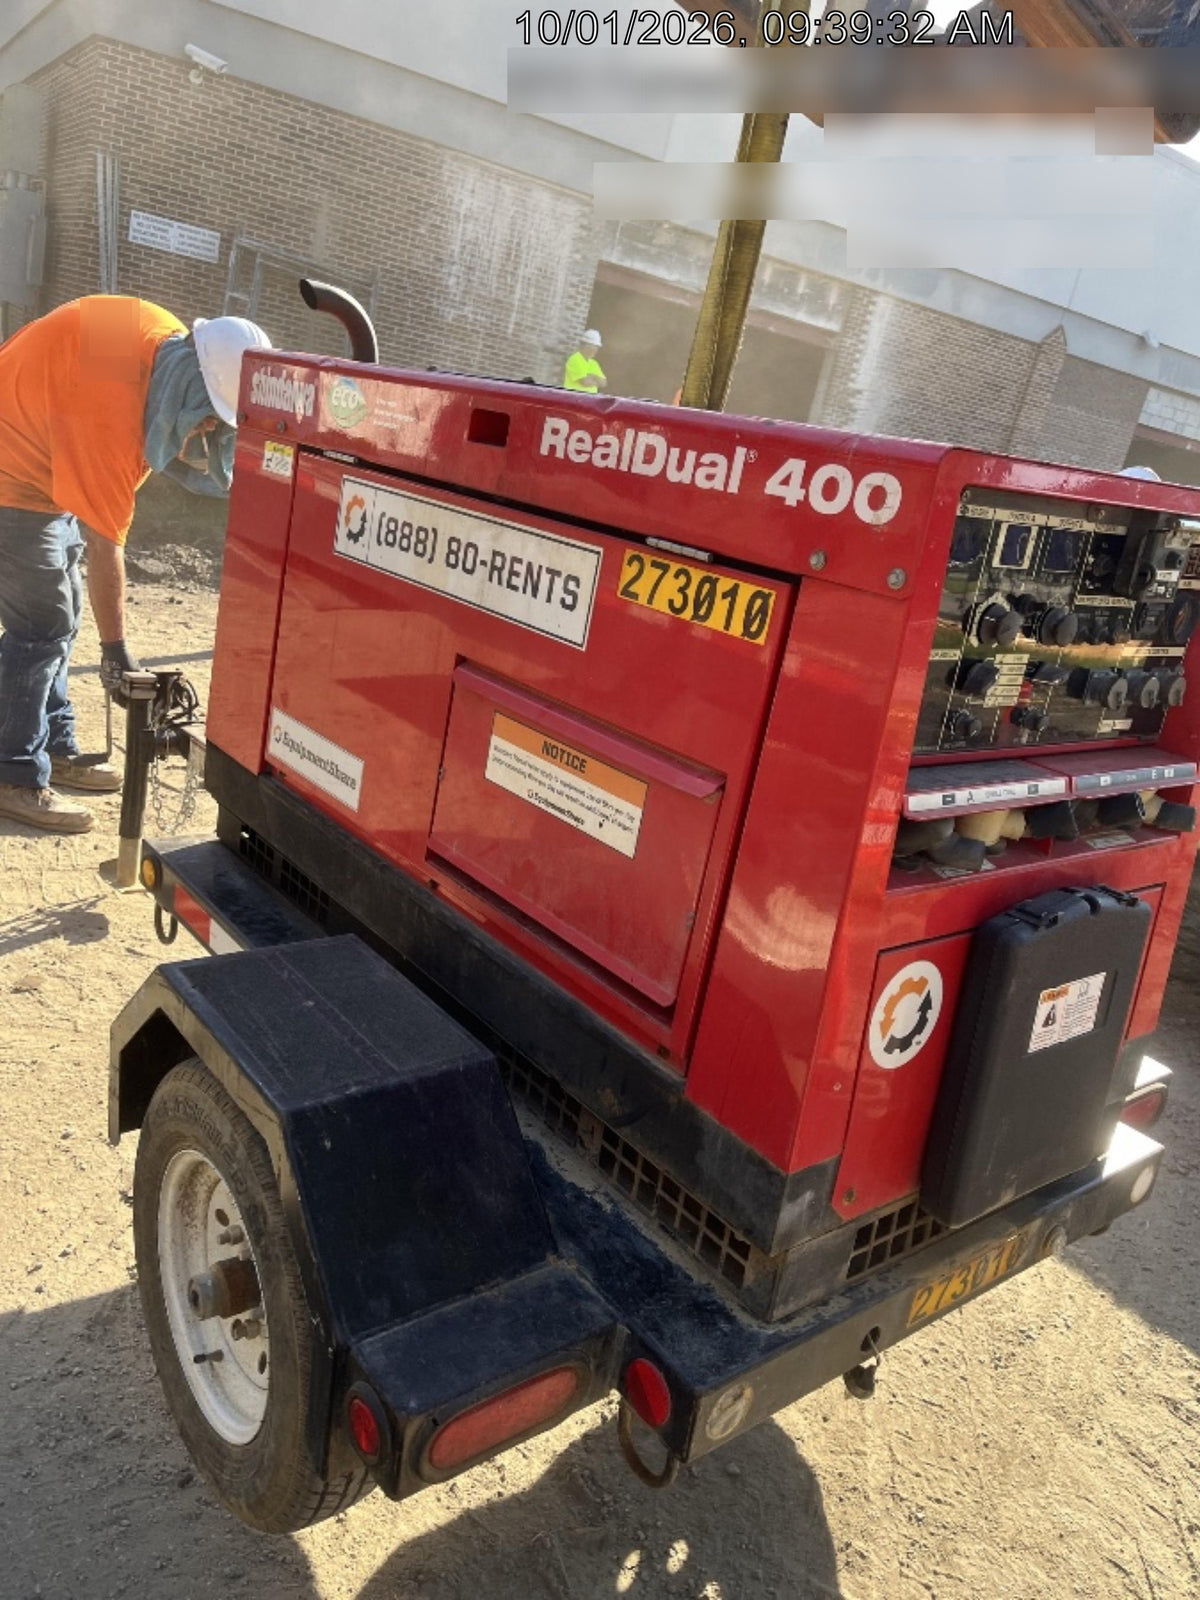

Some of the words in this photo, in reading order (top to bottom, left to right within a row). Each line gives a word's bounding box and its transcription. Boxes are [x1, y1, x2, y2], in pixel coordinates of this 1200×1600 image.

[763, 457, 903, 525] 400
[376, 511, 438, 564] (888)
[445, 536, 581, 612] 80-RENTS
[618, 552, 774, 642] 273010
[541, 740, 588, 775] NOTICE
